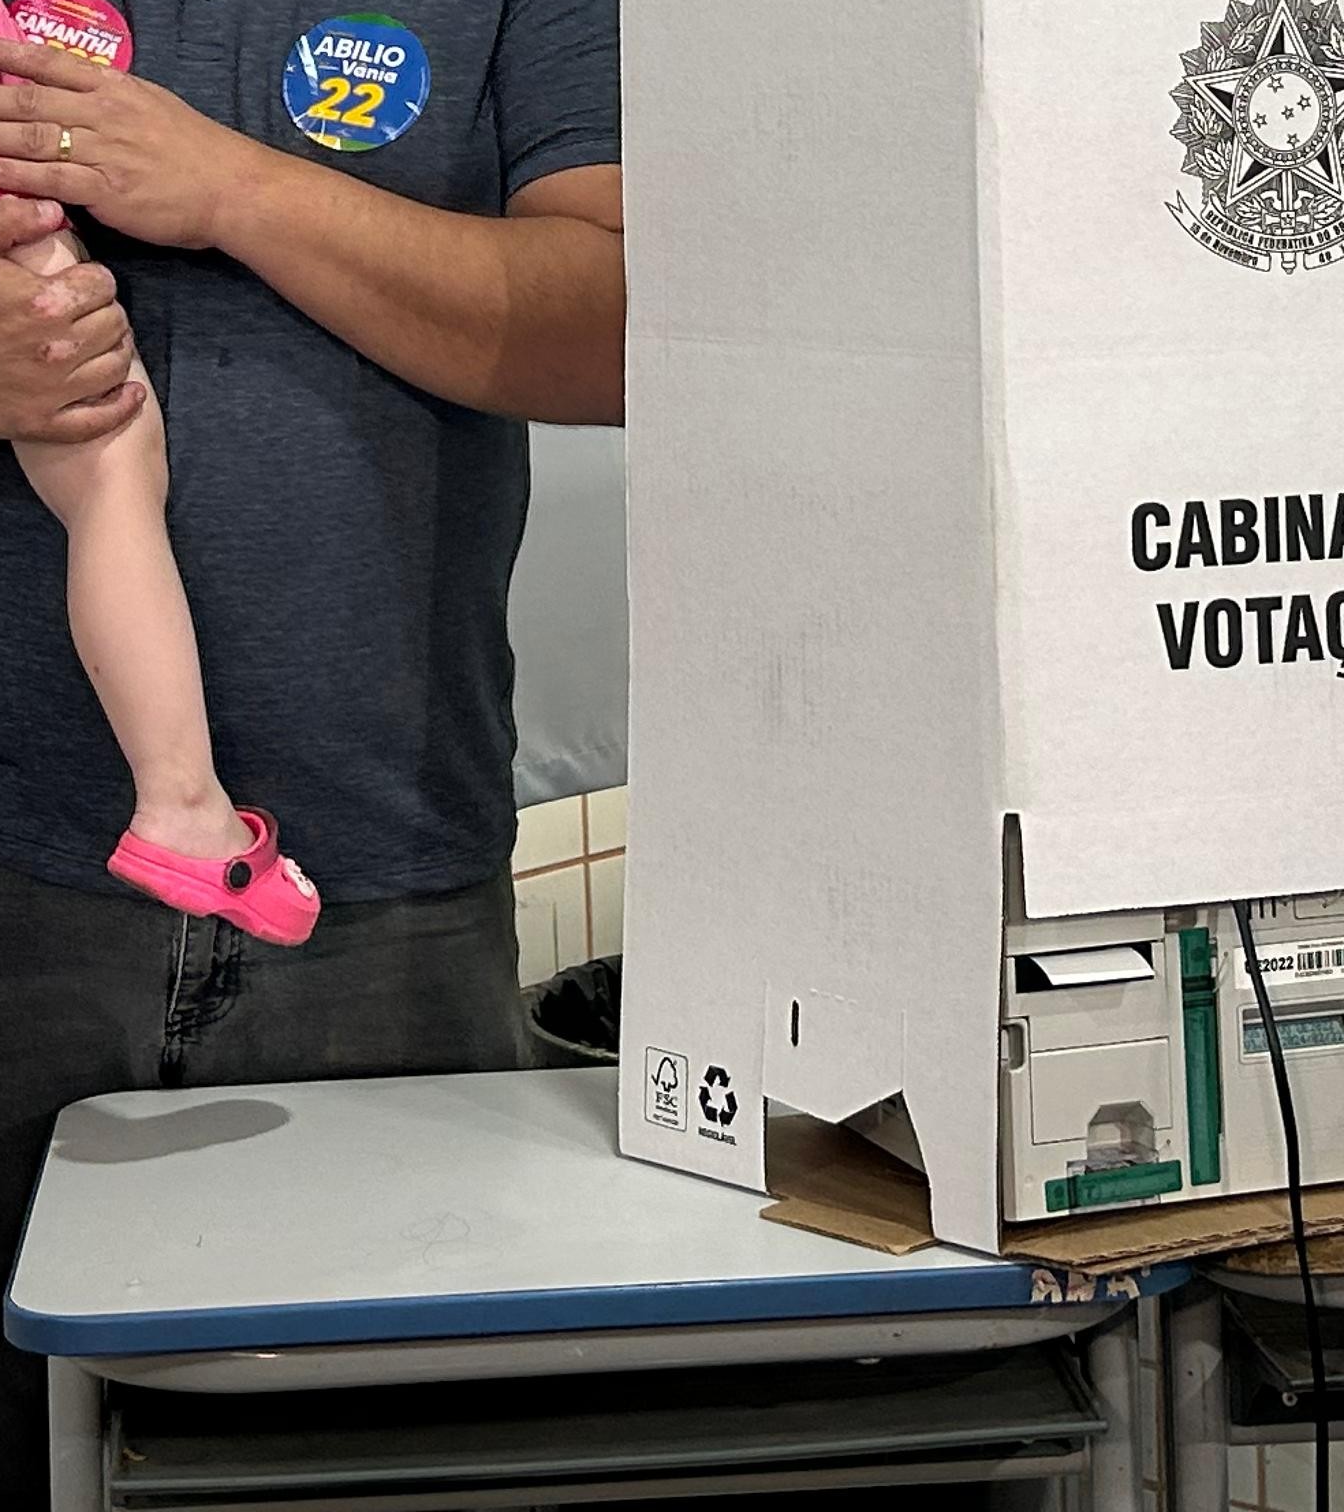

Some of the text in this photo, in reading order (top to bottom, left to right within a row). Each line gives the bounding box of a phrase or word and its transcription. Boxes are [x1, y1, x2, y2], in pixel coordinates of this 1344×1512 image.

[15, 11, 118, 60] SAMANTHA
[313, 36, 406, 68] ABILIO
[342, 60, 398, 85] Vânia
[307, 76, 385, 128] 22
[1258, 236, 1315, 250] FEDERATIVA
[1316, 229, 1331, 244] DO
